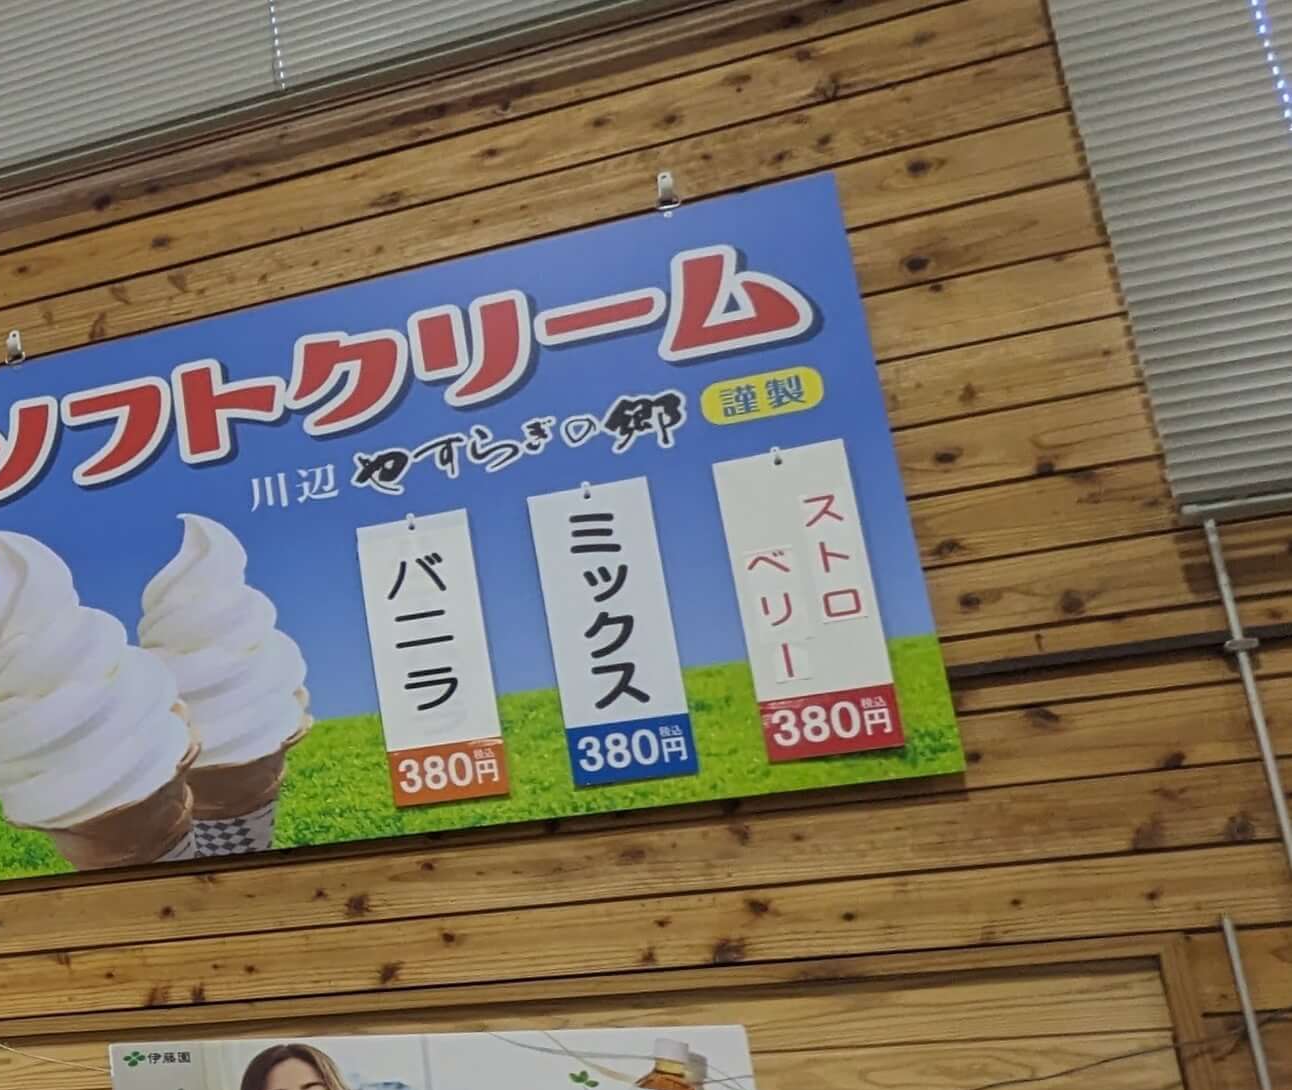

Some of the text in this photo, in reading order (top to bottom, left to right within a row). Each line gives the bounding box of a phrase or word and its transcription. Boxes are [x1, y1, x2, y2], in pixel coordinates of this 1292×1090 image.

[720, 374, 807, 418] 謹製
[250, 391, 685, 514] 川辺 やすらぎの郷
[803, 494, 862, 618] ストロ
[388, 553, 458, 711] バニラ
[569, 512, 651, 709] ミックス
[747, 550, 795, 678] ベリー
[577, 728, 688, 773] 380円
[771, 700, 893, 747] 380円
[398, 751, 500, 794] 380円
[147, 1051, 191, 1066] 伊藤園
